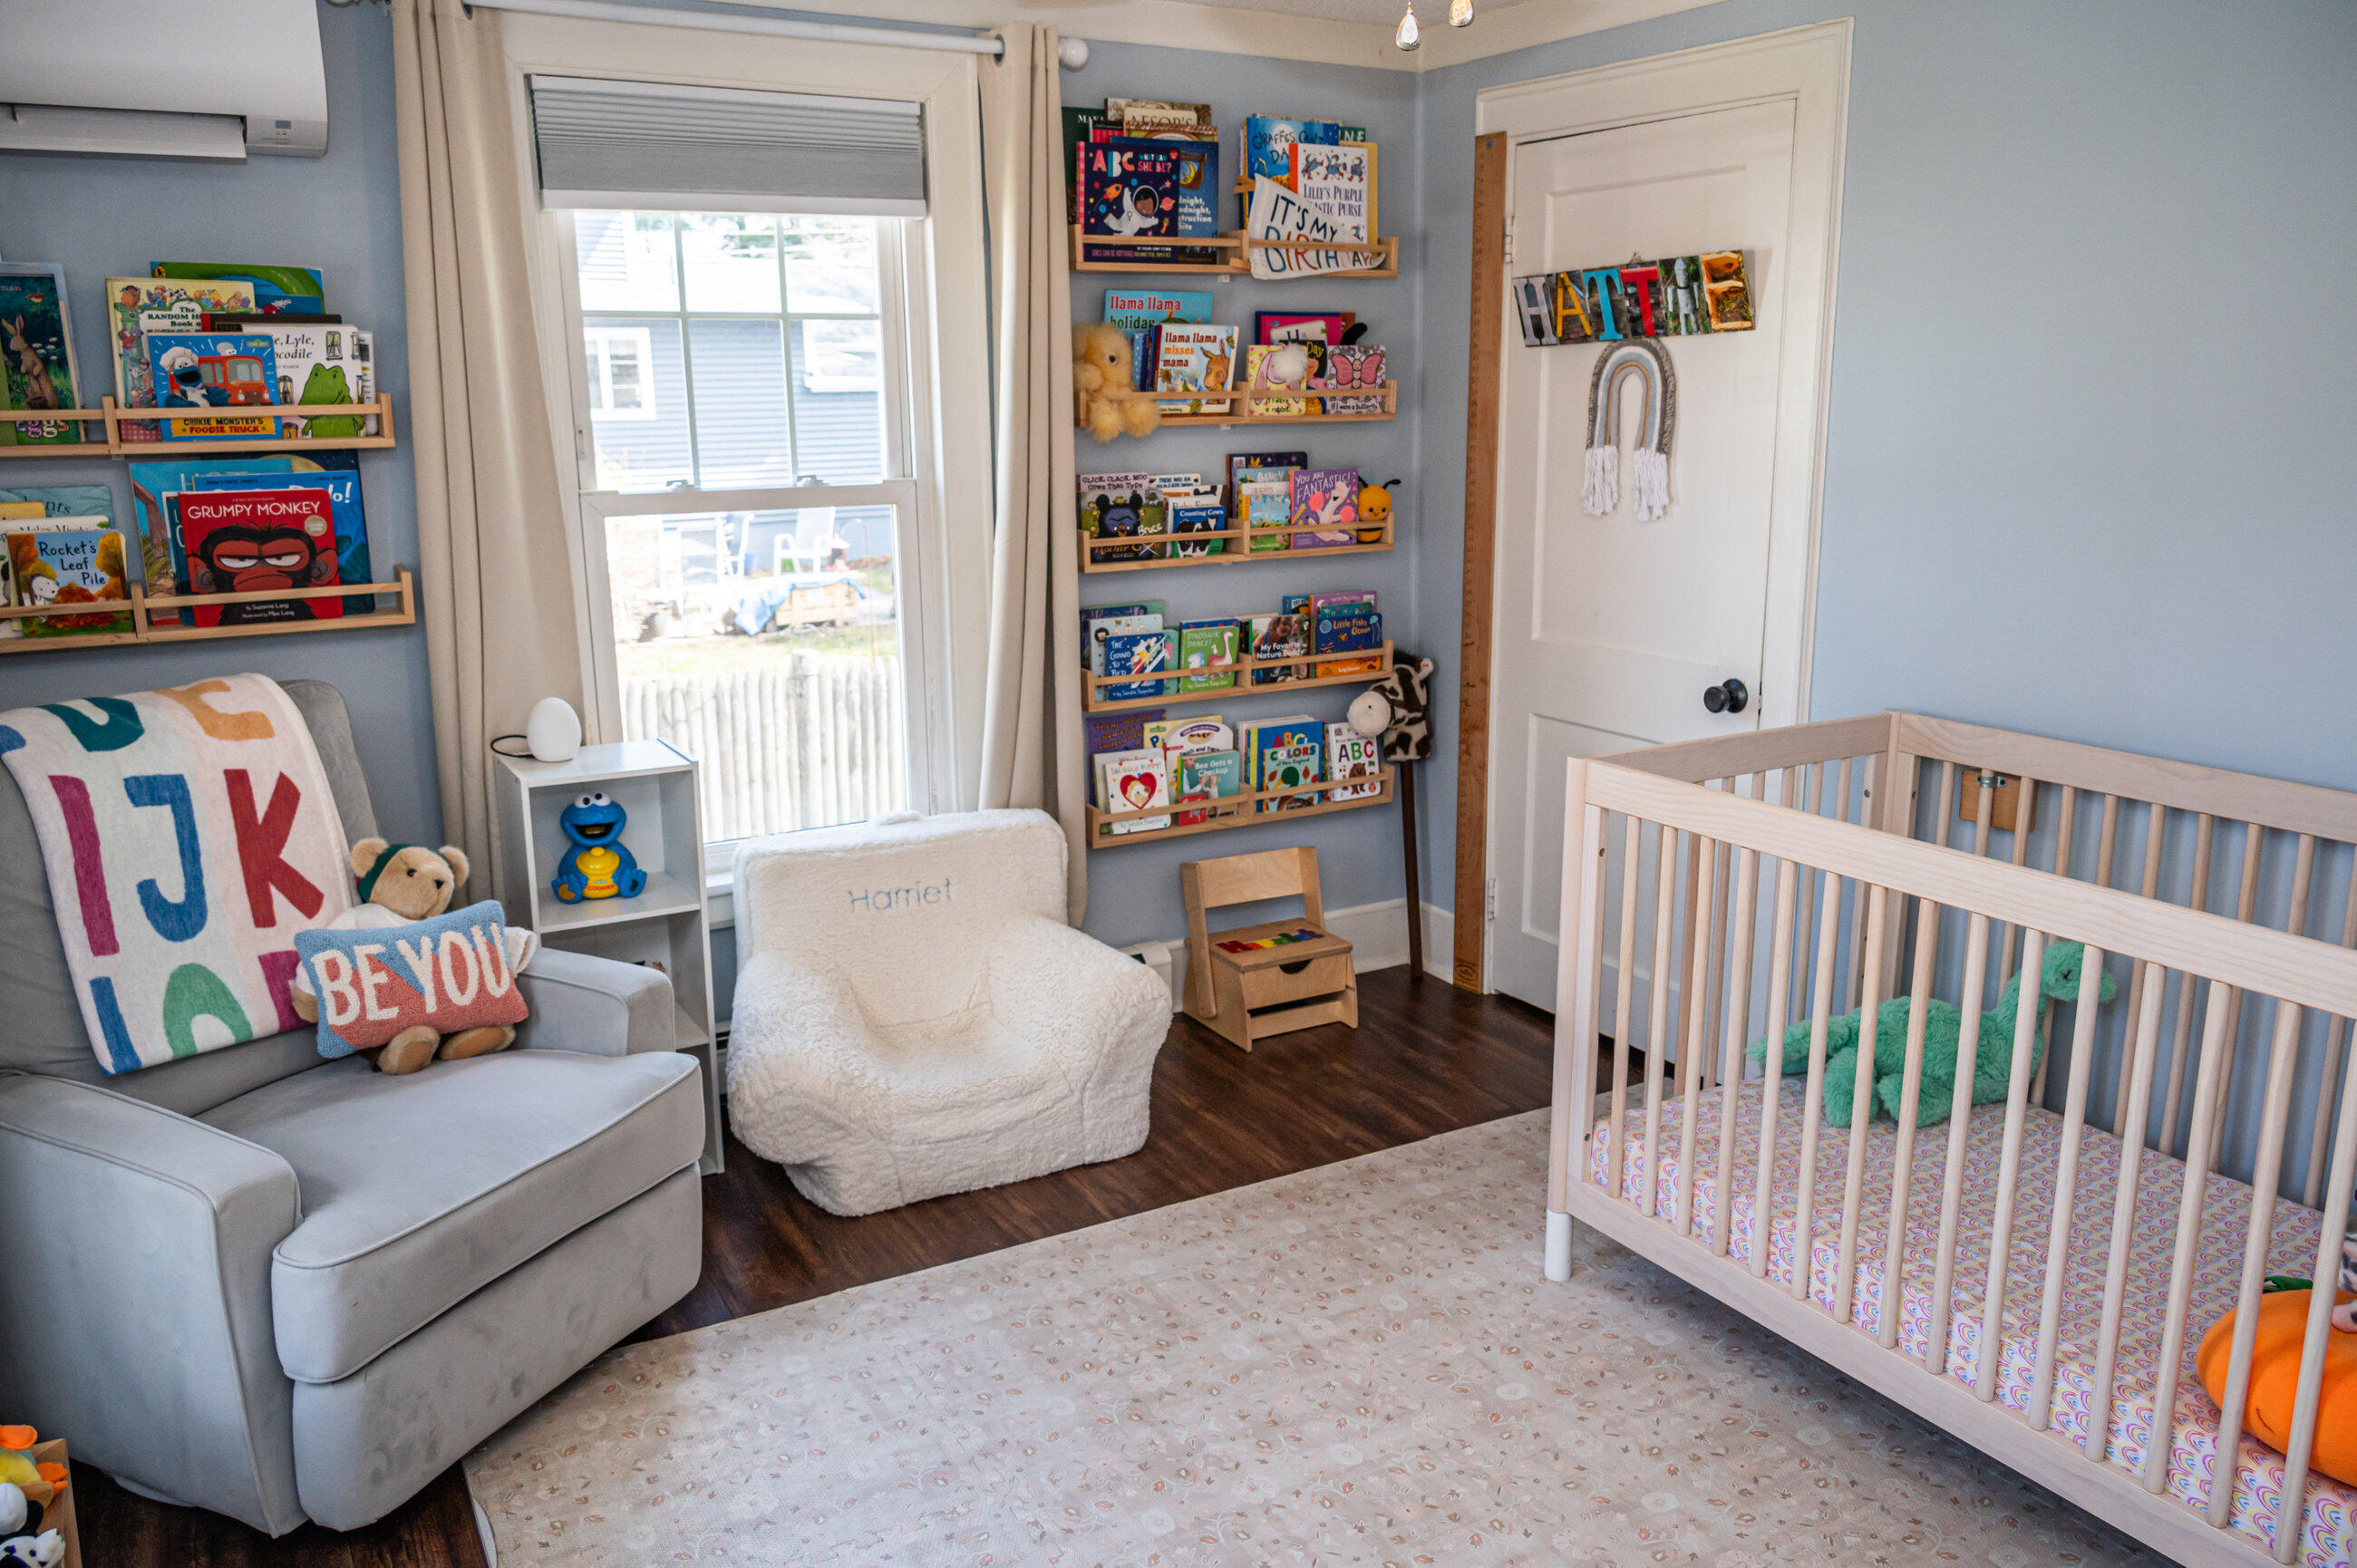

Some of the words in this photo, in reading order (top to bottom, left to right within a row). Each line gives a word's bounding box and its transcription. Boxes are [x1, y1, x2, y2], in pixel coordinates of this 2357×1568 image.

[1252, 130, 1295, 150] GIRAFFES
[1092, 150, 1135, 178] ABC
[1138, 160, 1152, 172] SHE
[1156, 161, 1172, 172] BE?
[1304, 183, 1331, 200] LILLY'S
[1334, 185, 1363, 202] PURPLE
[1338, 202, 1363, 218] PURSE
[1270, 193, 1309, 232] IT'S
[1310, 217, 1338, 243] MY
[1110, 295, 1144, 310] llama
[1147, 296, 1181, 311] llama
[286, 334, 315, 346] Lyle,
[1165, 332, 1190, 344] llama
[1193, 333, 1217, 344] llama
[1164, 344, 1195, 355] misses
[1162, 358, 1188, 367] mama
[183, 418, 213, 426] COOKIE
[216, 417, 264, 426] MONSTER'S
[189, 426, 226, 434] FOODIE
[229, 425, 260, 433] TRUCK
[1295, 473, 1311, 487] YOU
[1312, 471, 1325, 481] ARE
[1296, 471, 1352, 505] FANTASTIC!
[187, 504, 253, 519] GRUMPY
[257, 501, 321, 516] MONKEY
[1178, 509, 1208, 518] Counting
[38, 539, 98, 557] Rocket's
[61, 557, 90, 572] Leaf
[82, 570, 107, 586] Pile
[1333, 618, 1351, 630] Little
[1351, 626, 1372, 635] Ocean
[1111, 639, 1124, 650] THE
[1260, 644, 1272, 652] My
[1272, 641, 1301, 651] Favorite
[1109, 649, 1131, 661] GOING
[1256, 652, 1282, 660] Nature
[1283, 648, 1305, 658] Buddy
[1111, 661, 1120, 669] TO
[1269, 744, 1316, 761] COLORS
[1338, 740, 1374, 763] ABC
[1209, 760, 1227, 769] Gets
[1293, 758, 1311, 766] England
[1198, 767, 1229, 778] Checkup
[848, 877, 953, 913] Harriet
[310, 944, 400, 1027] BE
[395, 922, 511, 1014] YOU
